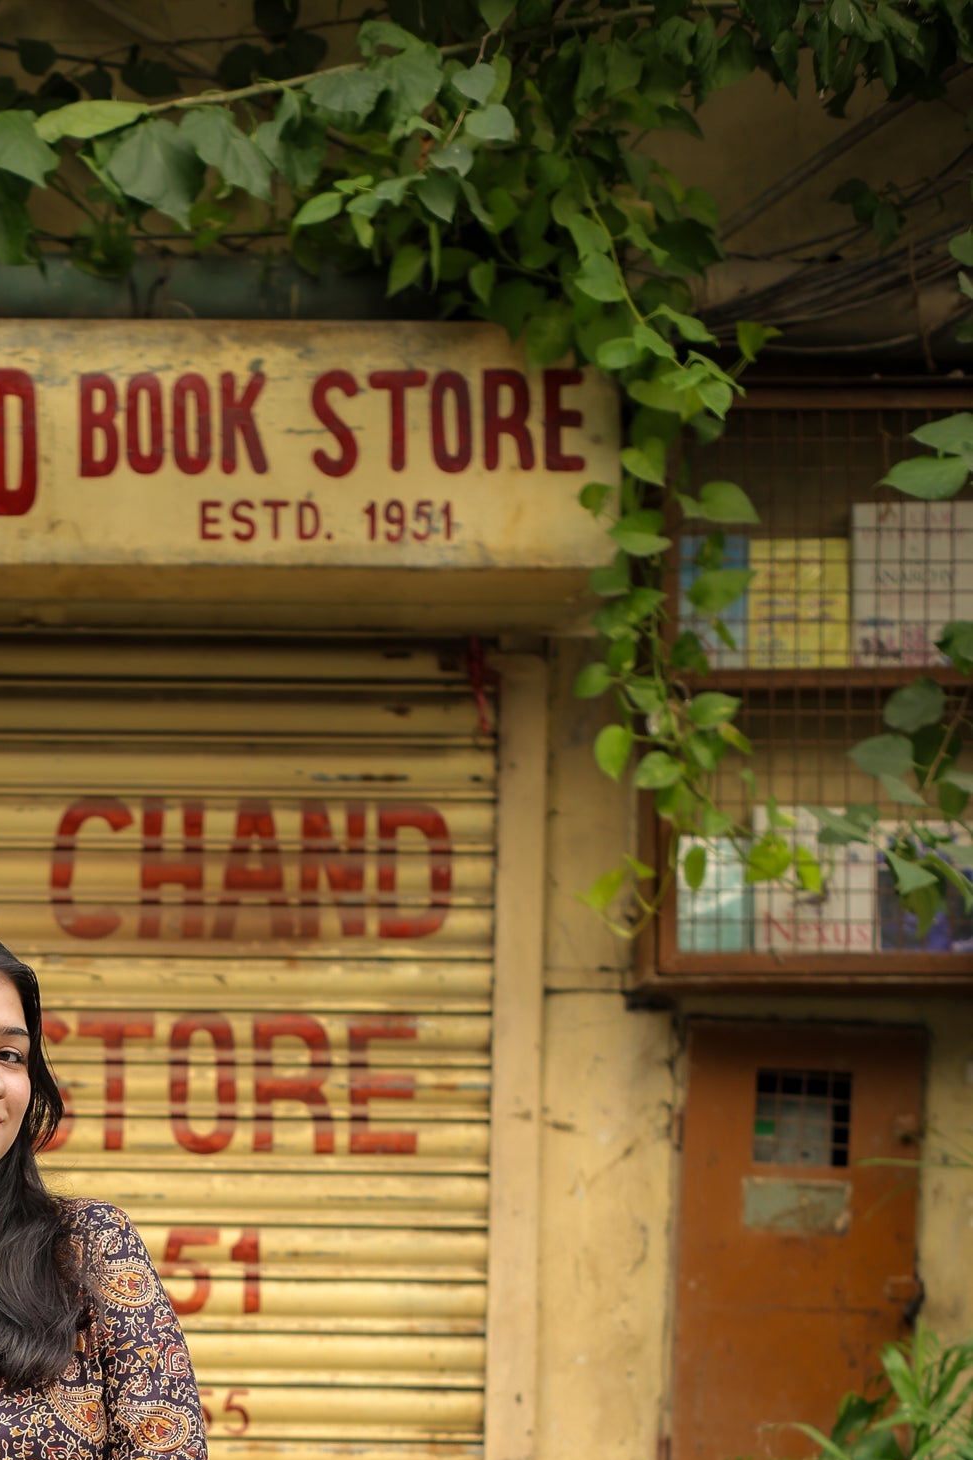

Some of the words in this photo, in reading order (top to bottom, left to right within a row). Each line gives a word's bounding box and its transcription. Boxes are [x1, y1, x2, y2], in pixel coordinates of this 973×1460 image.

[78, 370, 269, 478] BOOK
[311, 368, 586, 478] STORE
[199, 500, 332, 541] ESTD.
[363, 500, 454, 543] 1951
[49, 796, 453, 941] CHAND
